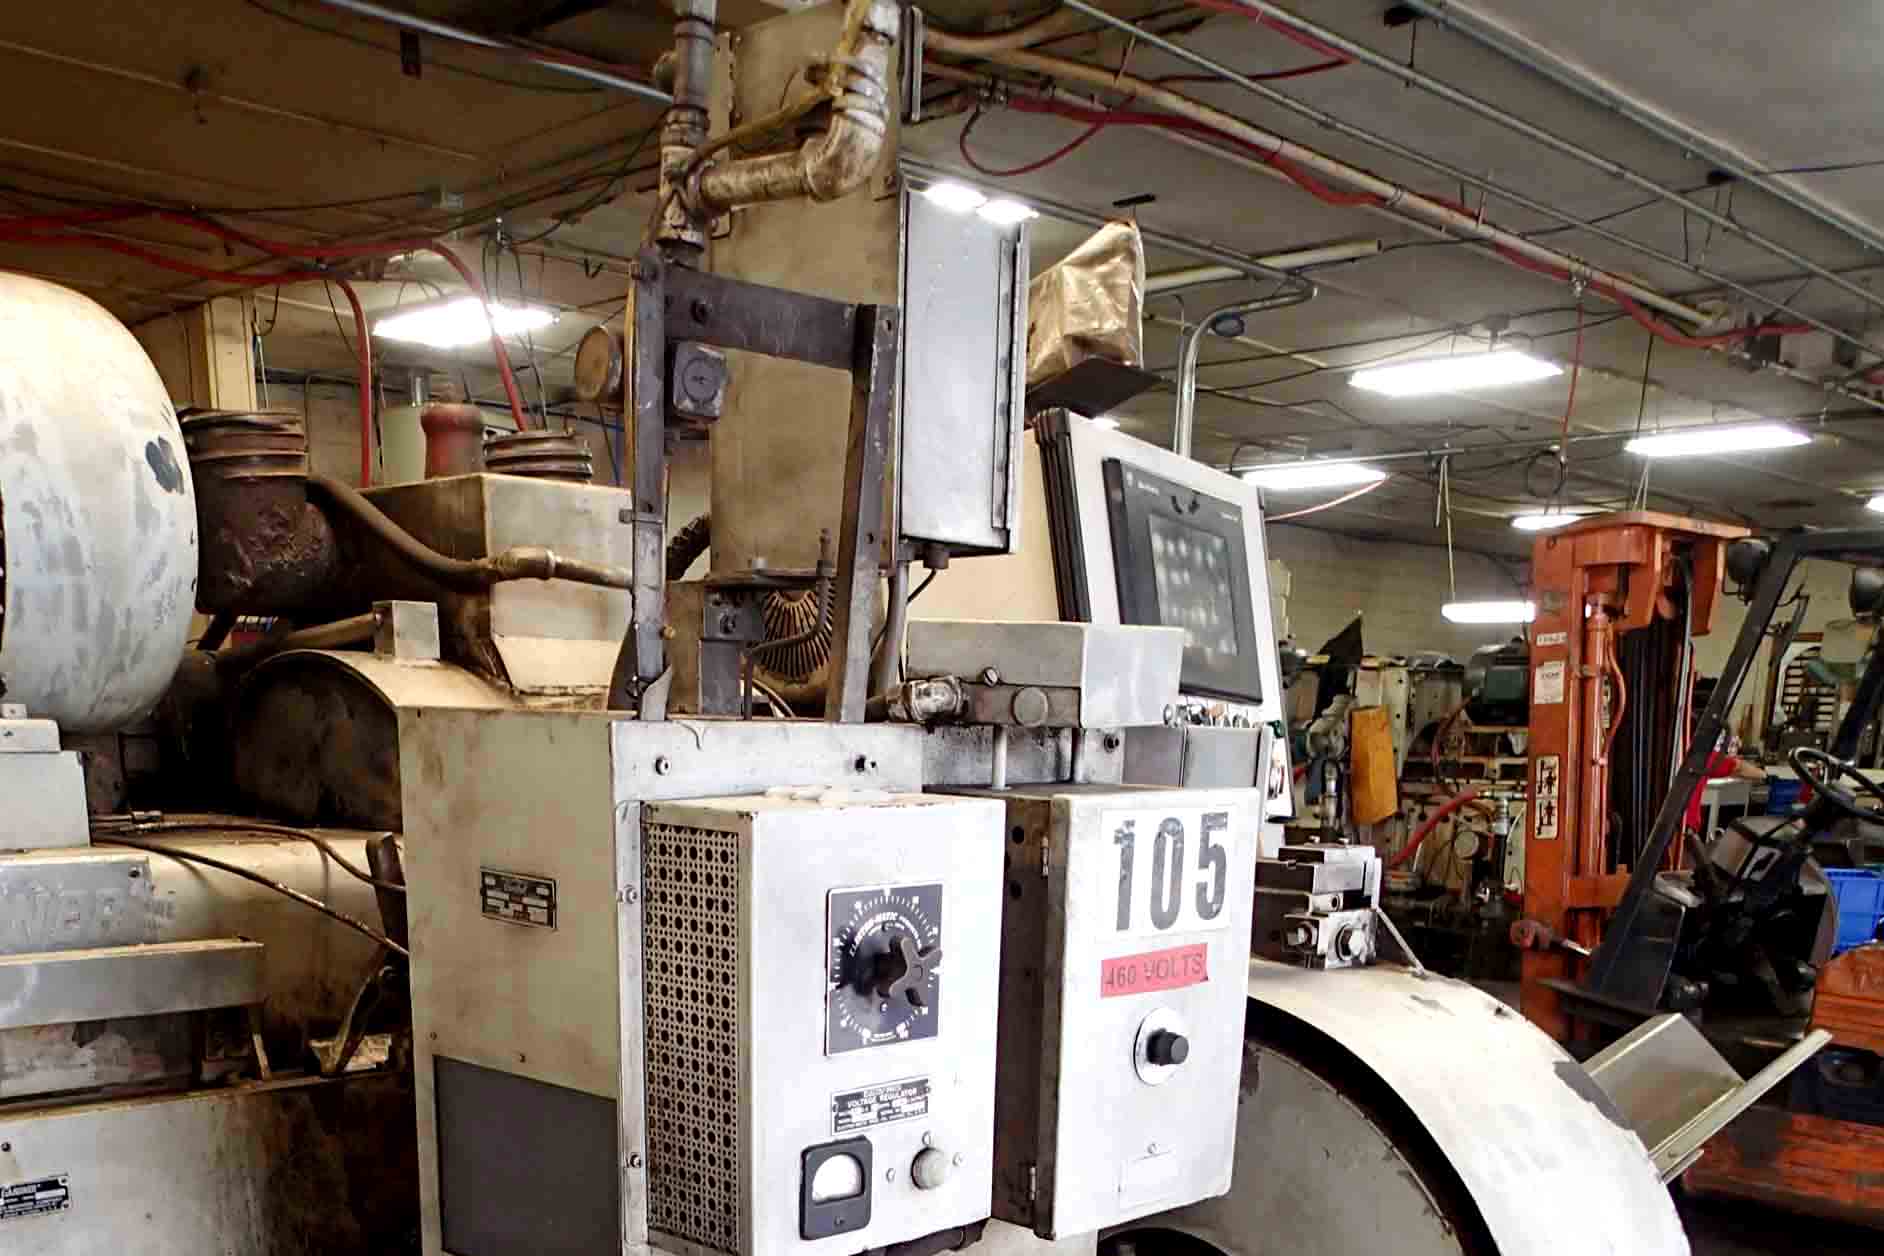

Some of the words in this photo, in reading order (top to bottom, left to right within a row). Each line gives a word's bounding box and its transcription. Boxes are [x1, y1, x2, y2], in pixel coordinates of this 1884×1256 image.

[1113, 811, 1229, 932] 105
[1103, 965, 1137, 989] 460
[1144, 951, 1204, 981] VOLTS
[879, 1087, 918, 1102] REGULATOR
